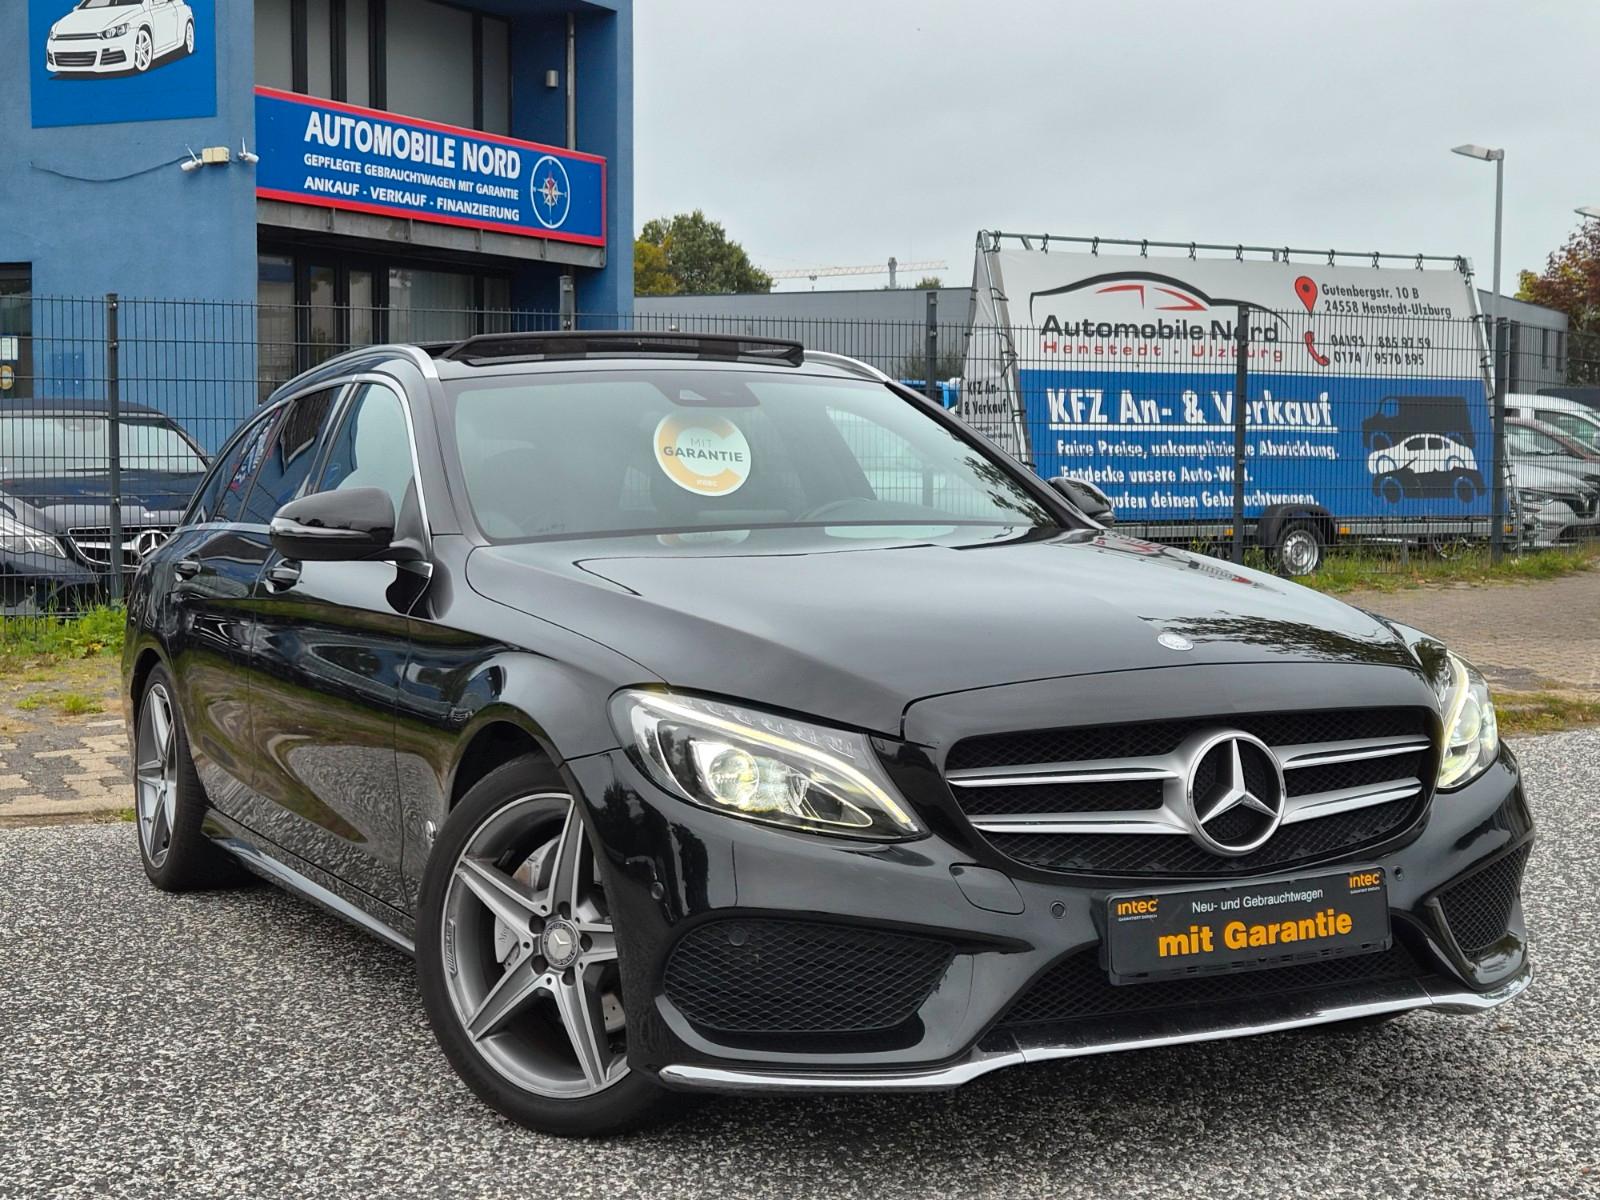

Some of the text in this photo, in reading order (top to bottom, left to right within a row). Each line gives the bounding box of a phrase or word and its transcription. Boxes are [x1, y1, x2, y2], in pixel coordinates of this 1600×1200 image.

[304, 111, 521, 180] AUTOMOBILE NORD
[304, 153, 520, 201] GEPFLEGTE GEBRAUCHTWAGEN MIT GARANTIE
[304, 176, 360, 197] ANKAUF
[370, 186, 427, 207] VERKAUF
[437, 197, 520, 222] FINANZIERUNG
[1322, 284, 1420, 300] Gutenbergstr. 10 B
[1325, 300, 1452, 319] 24558 Henstedt-Ulzburg
[1040, 315, 1204, 340] Automobile
[1043, 341, 1162, 357] Henstedt
[966, 381, 1000, 395] KFZ An-
[964, 398, 1007, 415] & Verkauf
[1047, 388, 1108, 424] KFZ
[1120, 390, 1172, 424] An-
[1182, 390, 1207, 425] &
[663, 446, 743, 462] GARANTIE
[1057, 440, 1340, 460] Faire Preise, unkompliziee Abwicklung.
[1129, 469, 1176, 482] unsere
[1181, 466, 1254, 482] Auto-Wt.
[1151, 491, 1198, 509] deinen
[1202, 490, 1320, 508] Gebruchtwagen.
[1349, 871, 1380, 889] intec
[1117, 899, 1158, 916] intec
[1192, 888, 1324, 914] Neu- und Gebrauchtwagen
[1158, 908, 1353, 957] mit Garantie
